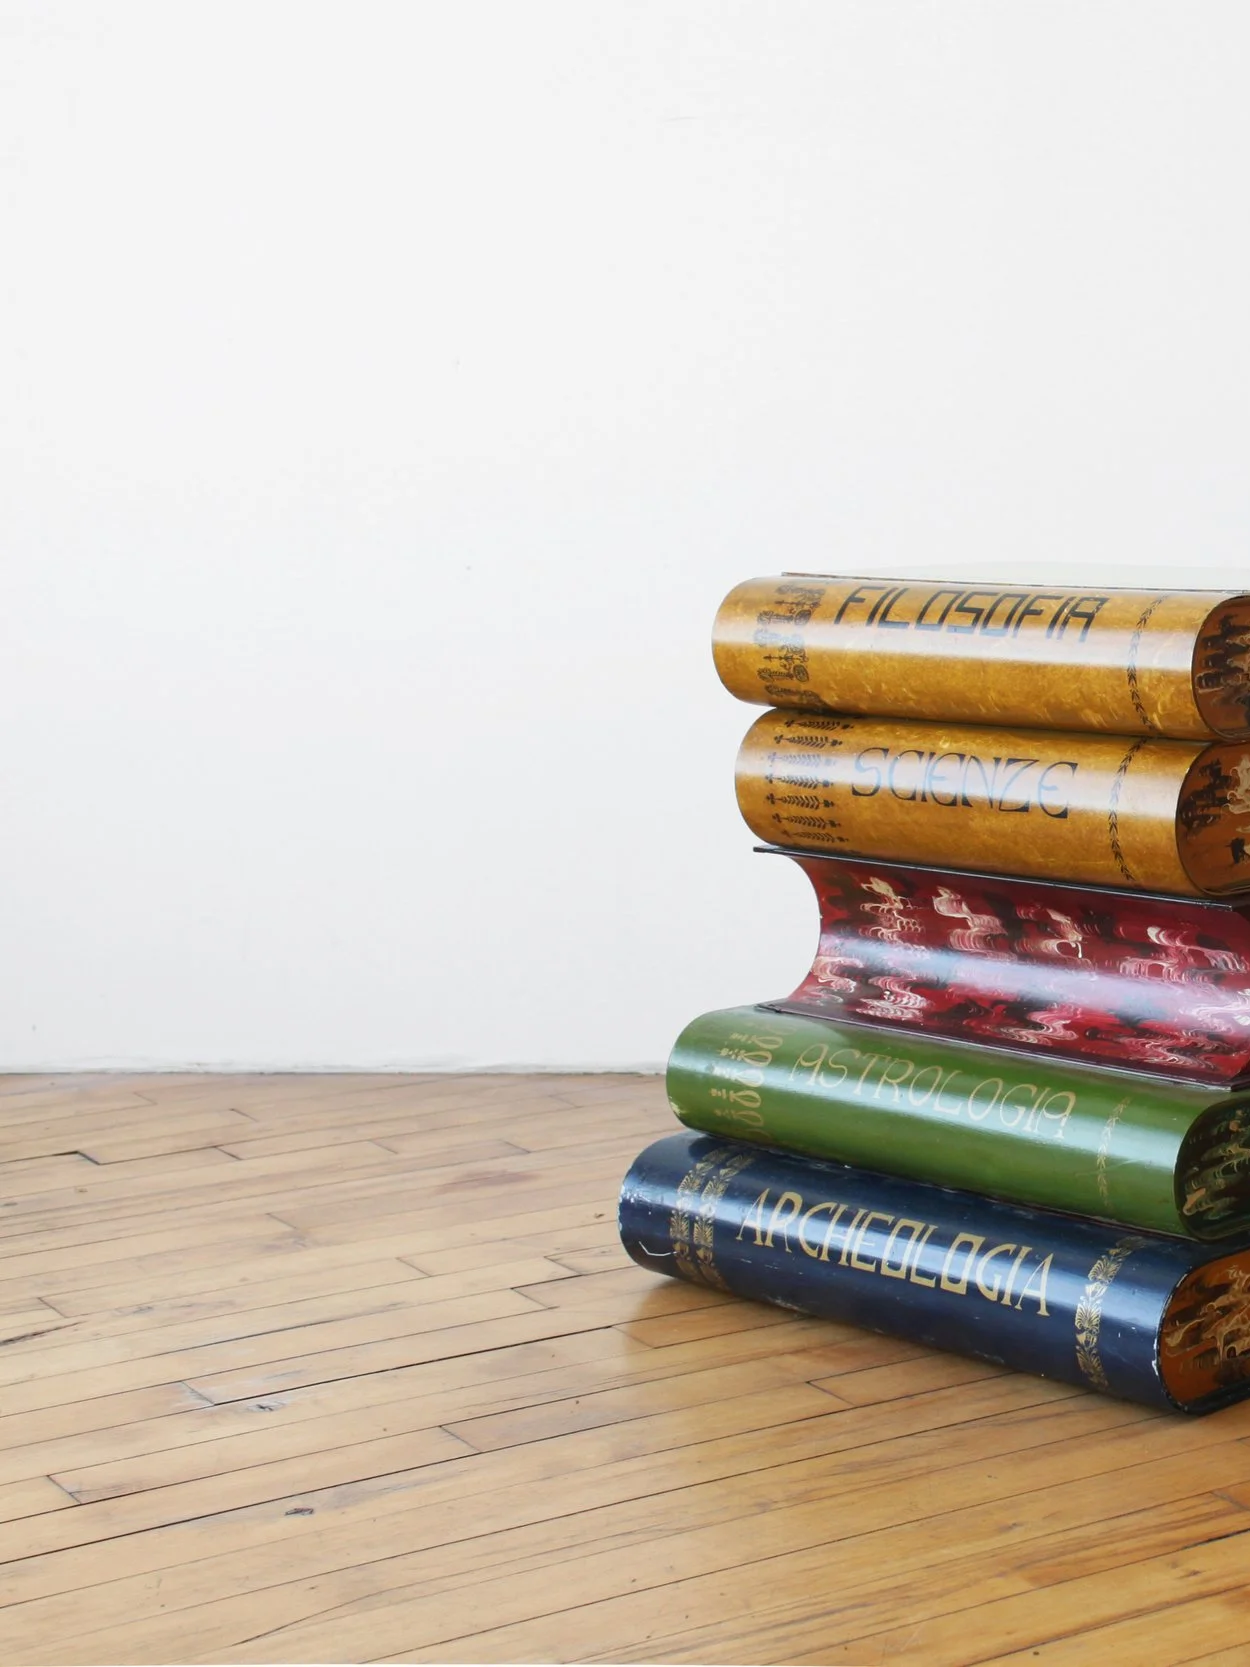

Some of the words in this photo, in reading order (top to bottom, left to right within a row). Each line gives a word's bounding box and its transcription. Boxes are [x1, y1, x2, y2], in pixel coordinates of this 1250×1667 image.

[834, 586, 1109, 643] FILOSOFIA
[851, 747, 1079, 819] SCIENZE
[788, 1043, 1077, 1139] ASTROLOGIA
[735, 1188, 1055, 1317] ARCHEOLOGIA
